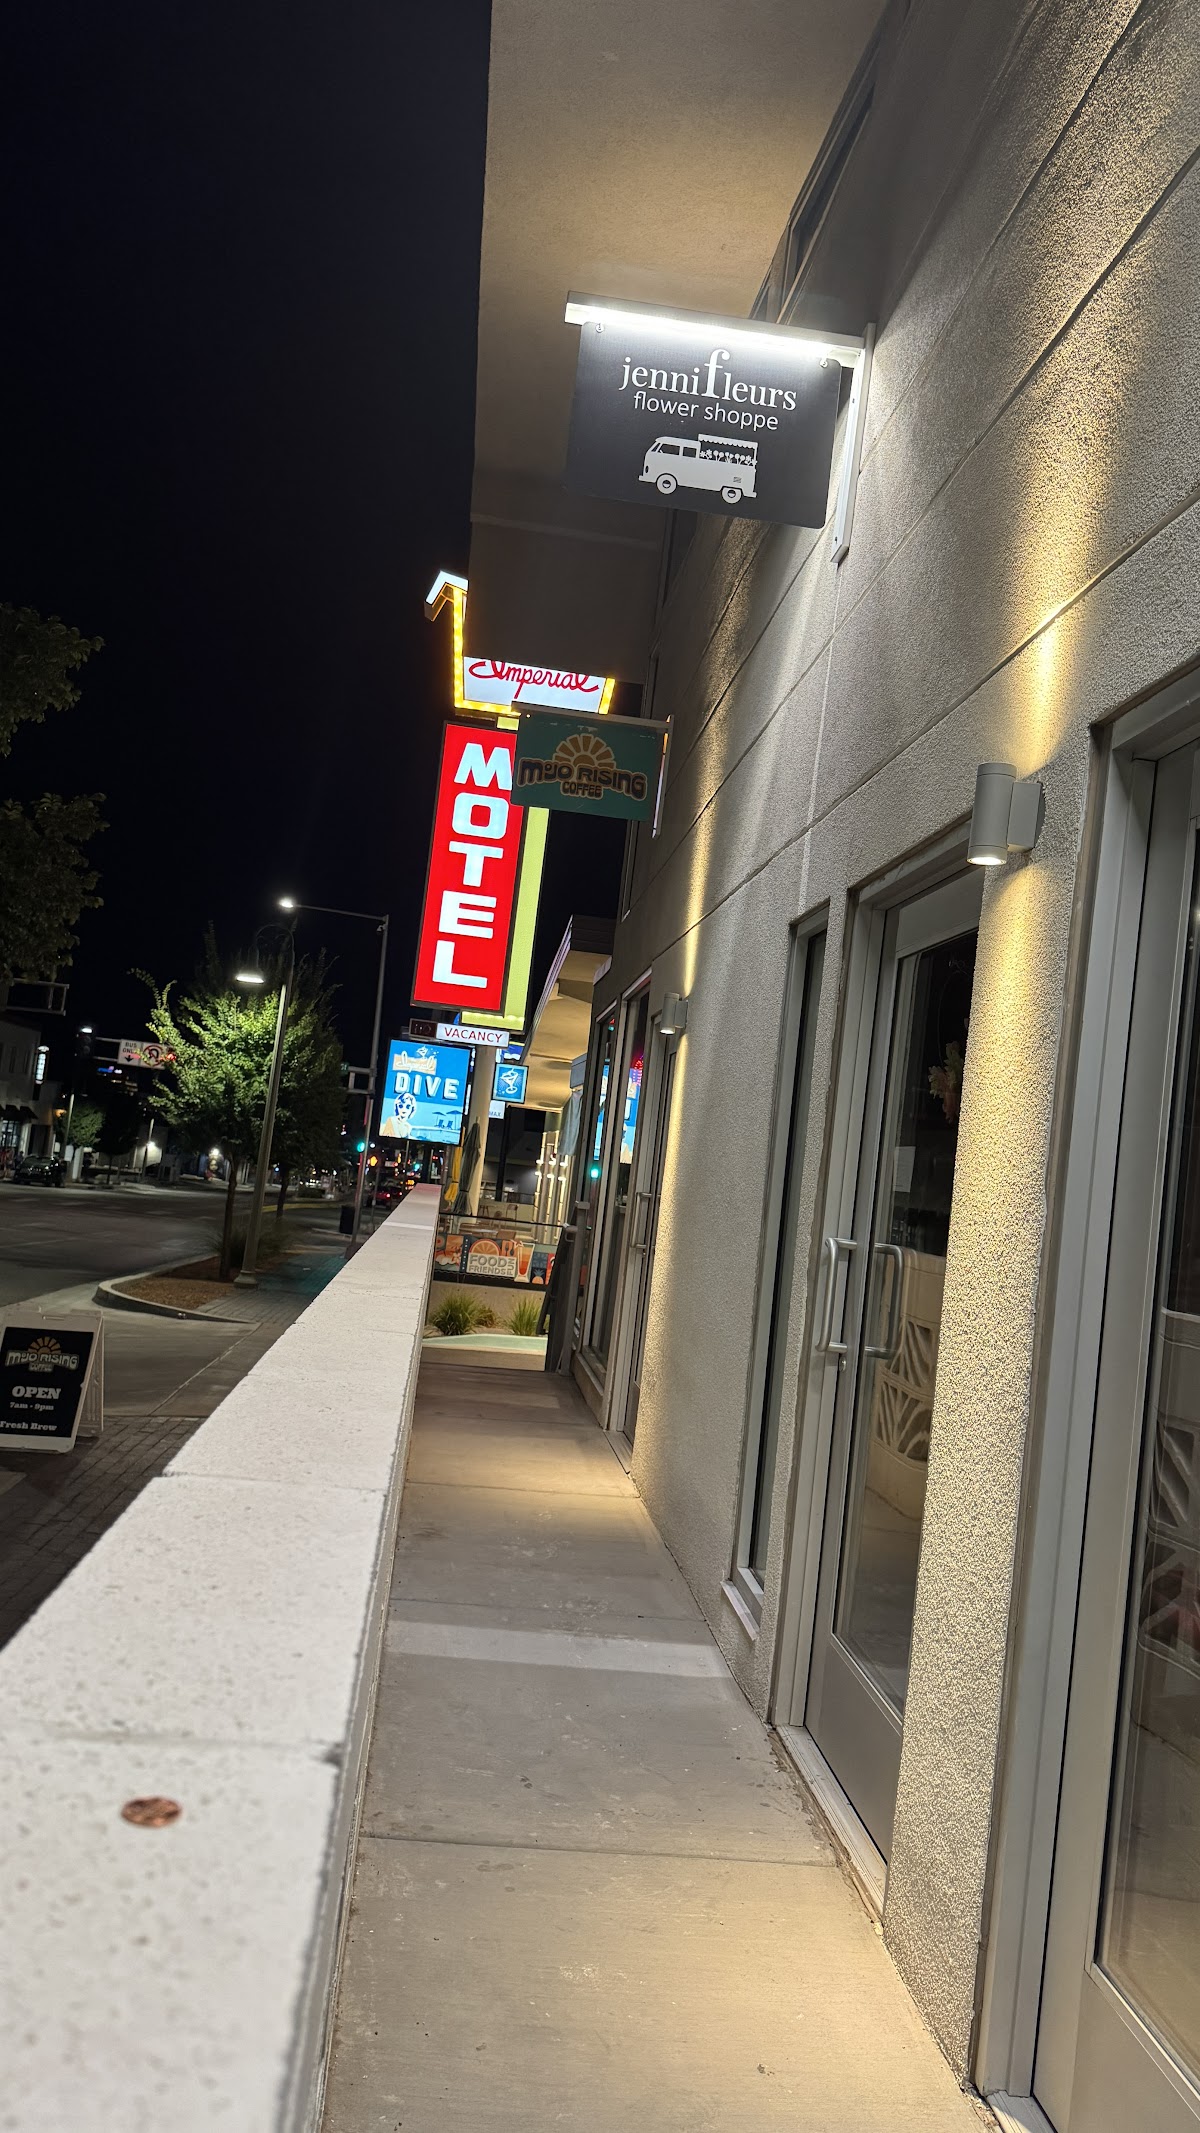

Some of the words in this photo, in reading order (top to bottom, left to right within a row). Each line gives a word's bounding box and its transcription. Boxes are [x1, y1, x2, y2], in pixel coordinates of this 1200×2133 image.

[633, 390, 699, 418] flower
[703, 402, 779, 432] shoppe
[561, 781, 603, 799] COFFEE
[432, 742, 513, 989] MOTEL
[444, 1027, 504, 1044] VACANCY
[394, 1071, 460, 1100] DIVE
[470, 1254, 508, 1268] FOOD
[468, 1264, 506, 1276] FRIENDS
[11, 1385, 62, 1400] OPEN
[9, 1401, 28, 1409] 7am
[0, 1420, 29, 1430] Fresh
[30, 1422, 58, 1431] Brew
